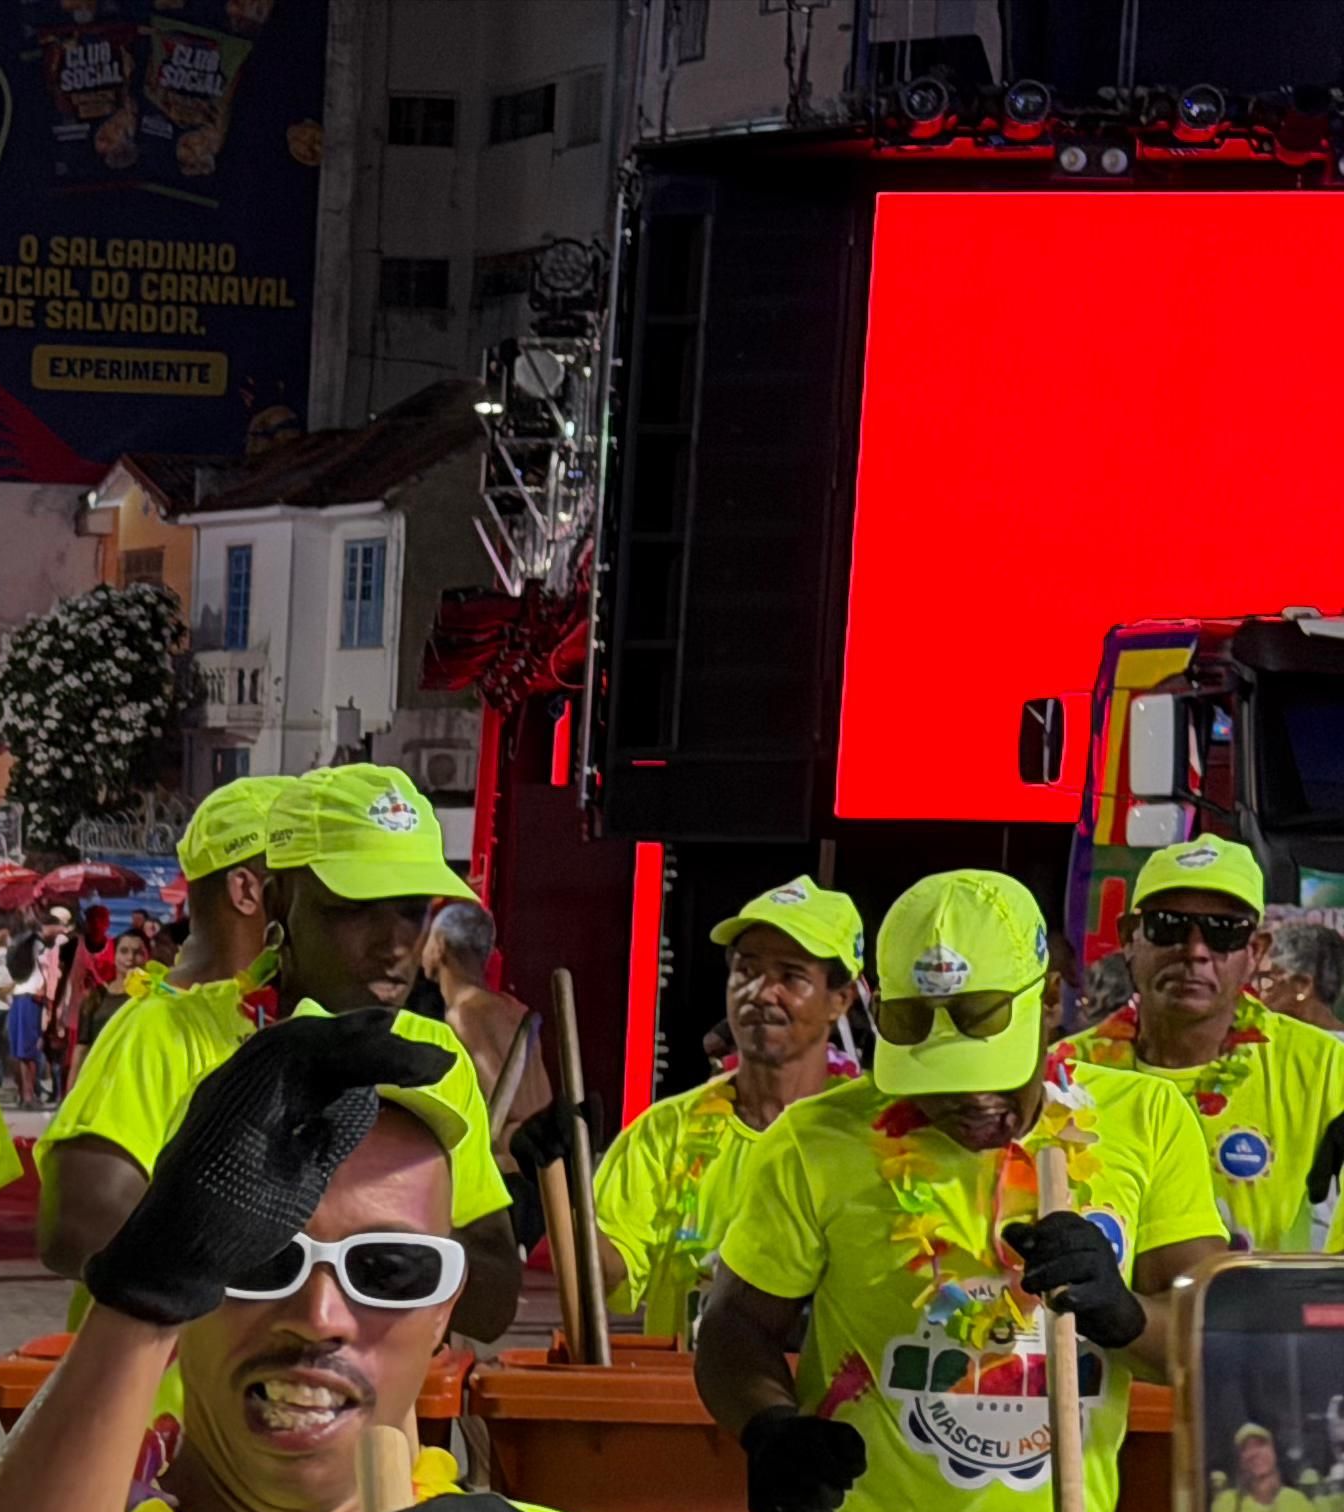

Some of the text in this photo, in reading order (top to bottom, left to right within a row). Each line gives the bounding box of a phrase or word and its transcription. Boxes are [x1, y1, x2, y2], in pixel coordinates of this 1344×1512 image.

[19, 234, 236, 273] O SALGADINHO
[91, 270, 130, 300] DO
[140, 272, 296, 308] CARNAVAL
[45, 301, 207, 336] SALVADOR.
[49, 356, 211, 385] EXPERIMENTE
[928, 1400, 1011, 1459] NASCEU
